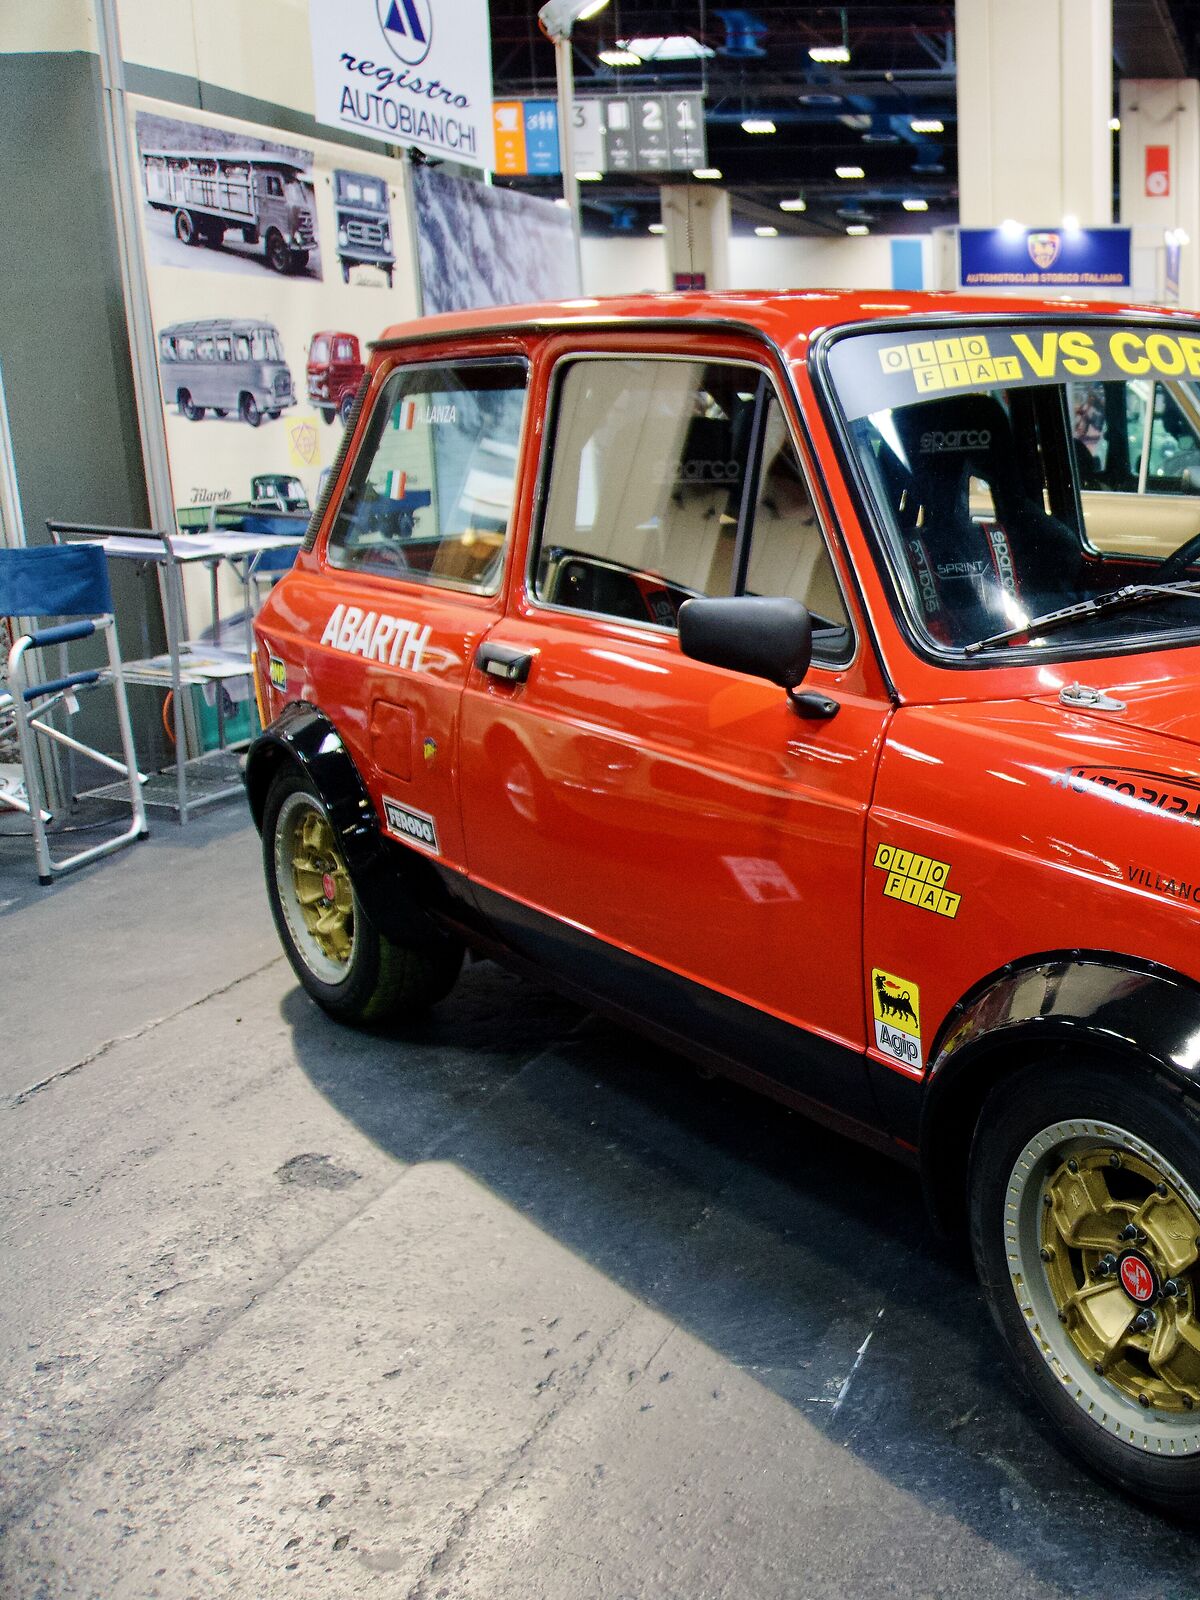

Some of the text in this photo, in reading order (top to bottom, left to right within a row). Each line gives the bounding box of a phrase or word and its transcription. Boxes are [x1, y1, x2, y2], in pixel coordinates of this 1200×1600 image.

[339, 52, 470, 109] registro
[340, 85, 477, 153] AUTOBIANCHI
[572, 105, 586, 128] 3
[641, 101, 664, 131] 2
[676, 100, 697, 131] 1
[966, 273, 1039, 284] AUTOMOTOCLUB
[1041, 273, 1079, 283] STORICO
[886, 339, 984, 368] OLIO
[1010, 331, 1102, 378] VS
[923, 361, 1013, 387] FIAT
[920, 430, 992, 449] sparco
[936, 559, 984, 574] SPRINT
[320, 603, 433, 673] ABARTH
[388, 806, 433, 842] FERODO
[879, 848, 945, 883] OLIO
[889, 878, 956, 911] FIAT
[879, 1024, 918, 1062] Agip
